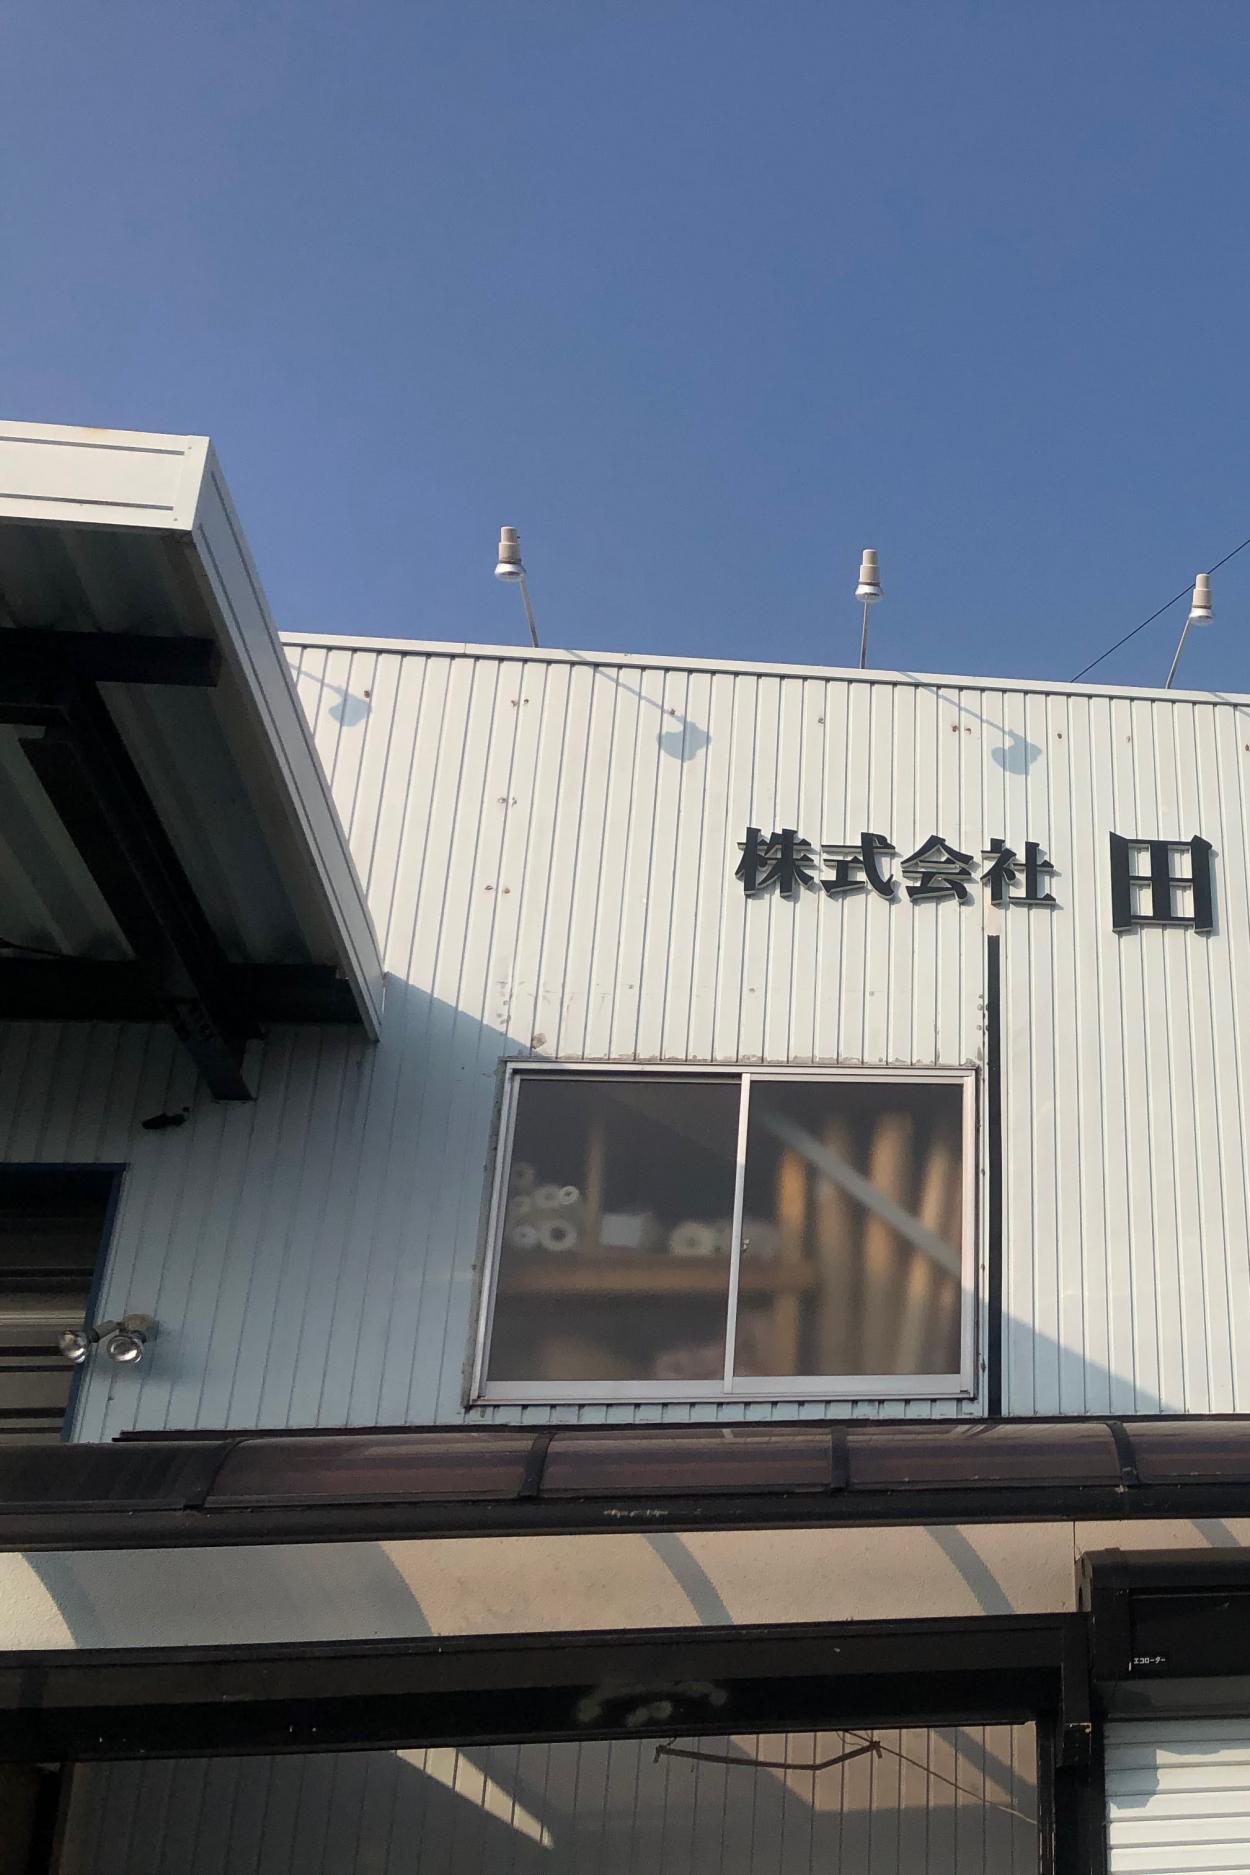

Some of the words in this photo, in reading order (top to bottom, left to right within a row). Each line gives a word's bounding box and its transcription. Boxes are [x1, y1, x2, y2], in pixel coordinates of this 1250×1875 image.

[736, 826, 1057, 907] 株式会社
[1133, 1656, 1166, 1664] エコローター
